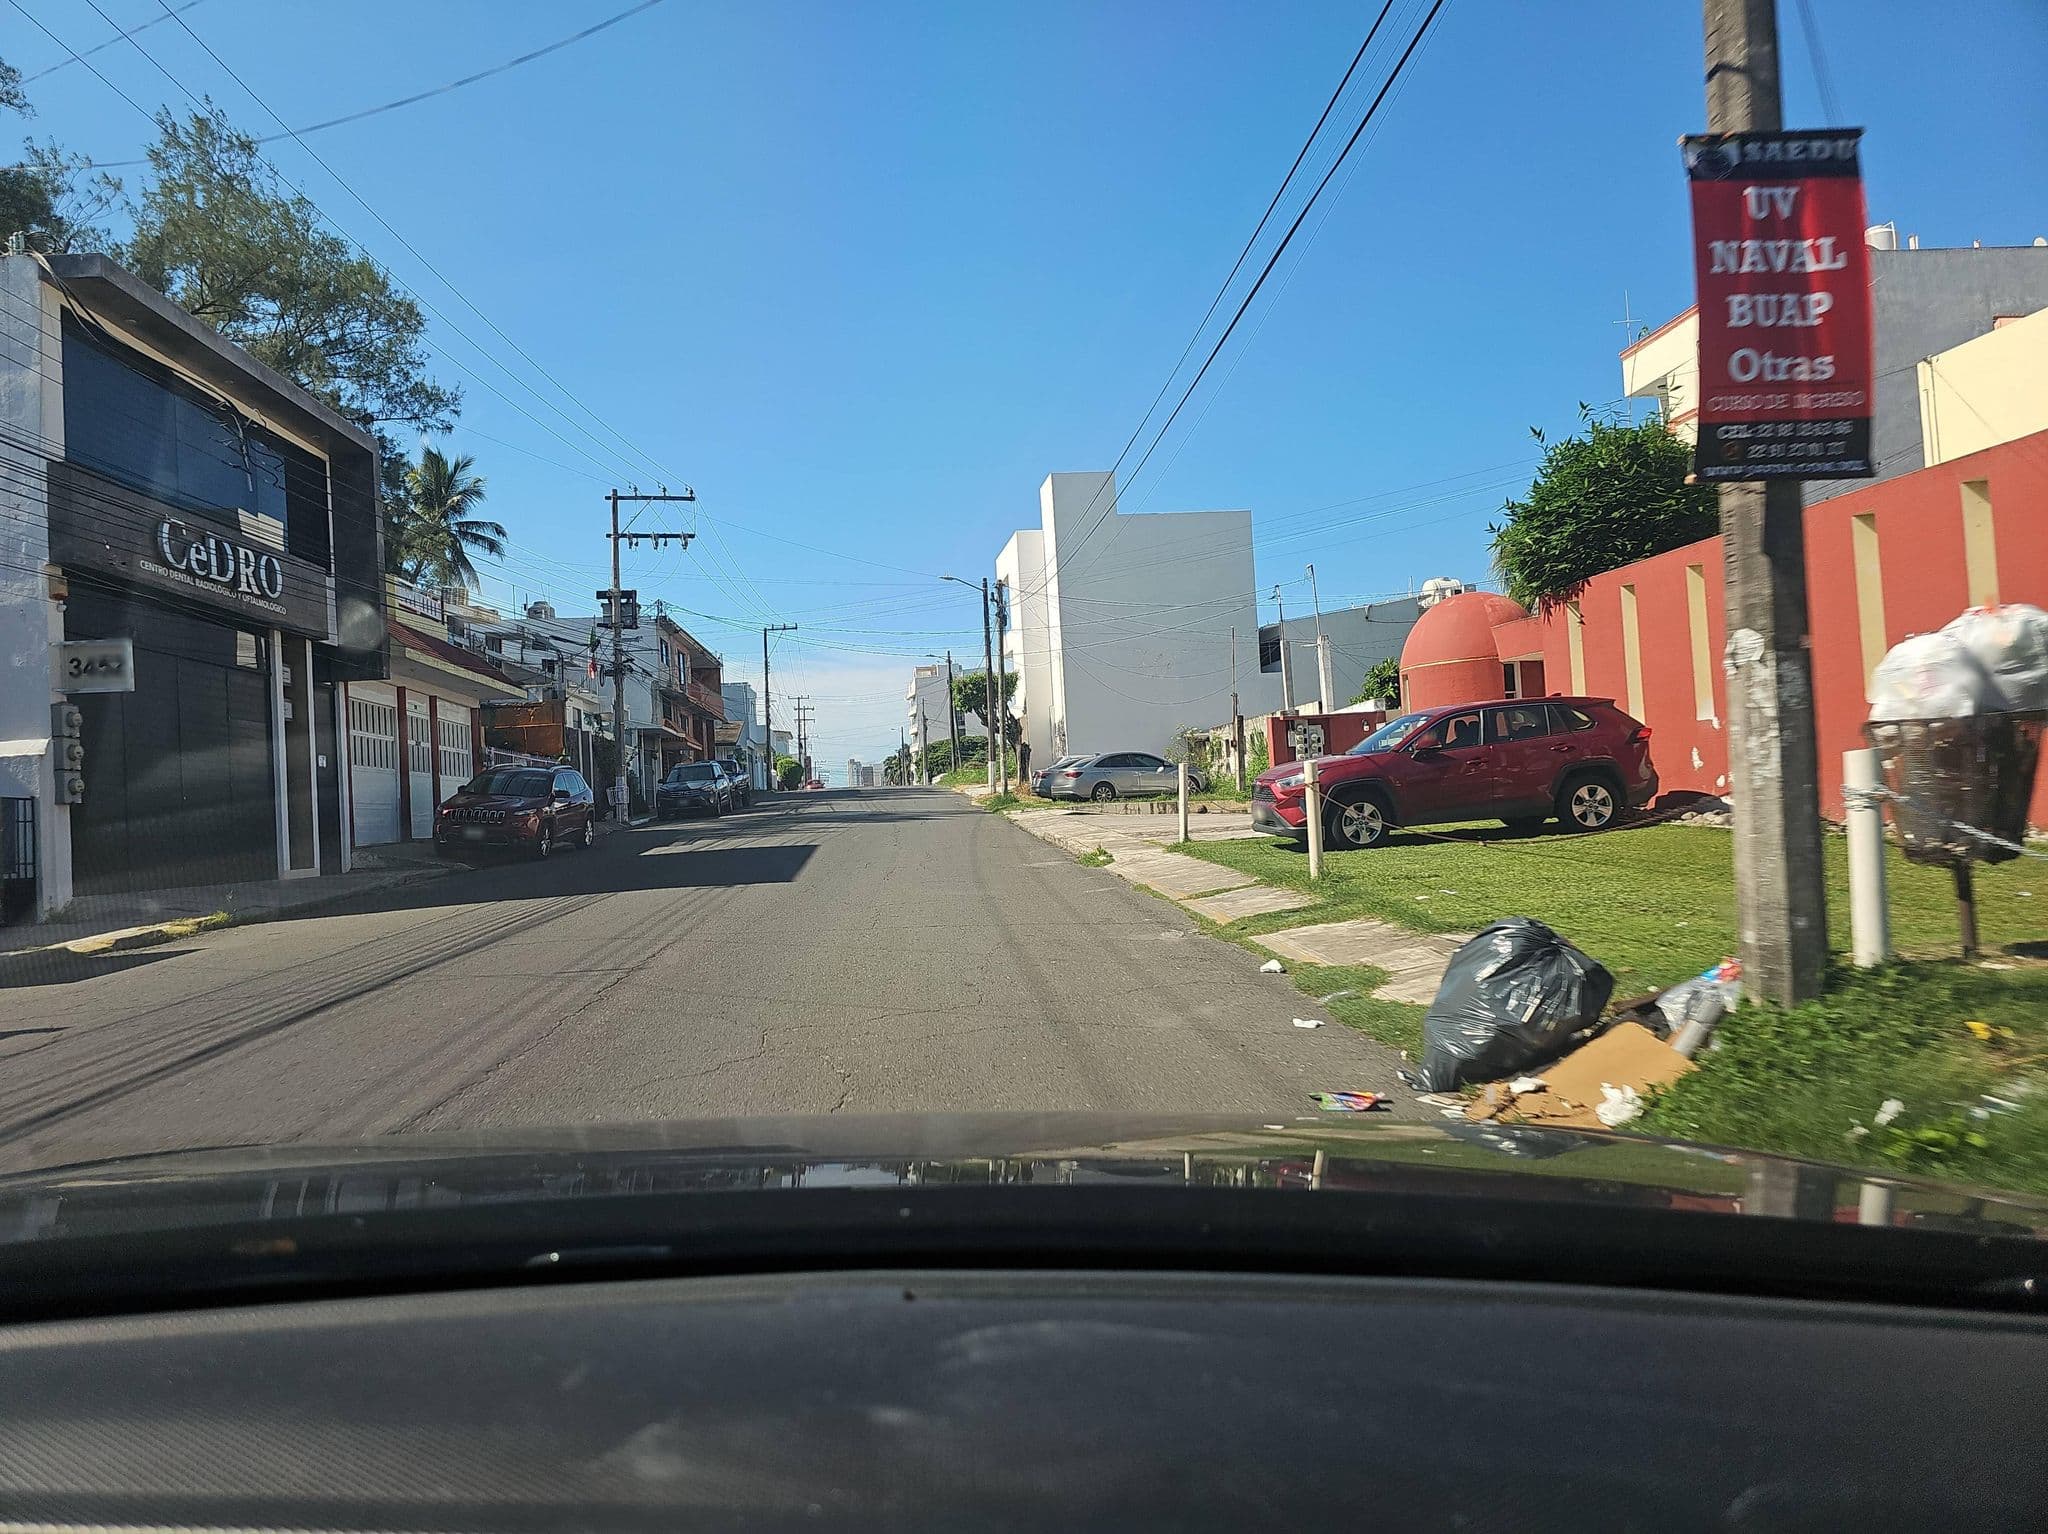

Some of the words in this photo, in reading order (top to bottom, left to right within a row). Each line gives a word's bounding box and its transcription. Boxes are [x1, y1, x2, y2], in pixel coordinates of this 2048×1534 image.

[1743, 185, 1800, 220] UV
[1708, 236, 1848, 274] NAVAL
[1726, 291, 1834, 328] BUAP
[1727, 347, 1836, 382] Otras
[140, 560, 168, 576] CENTRO
[169, 569, 195, 585] DENTAL
